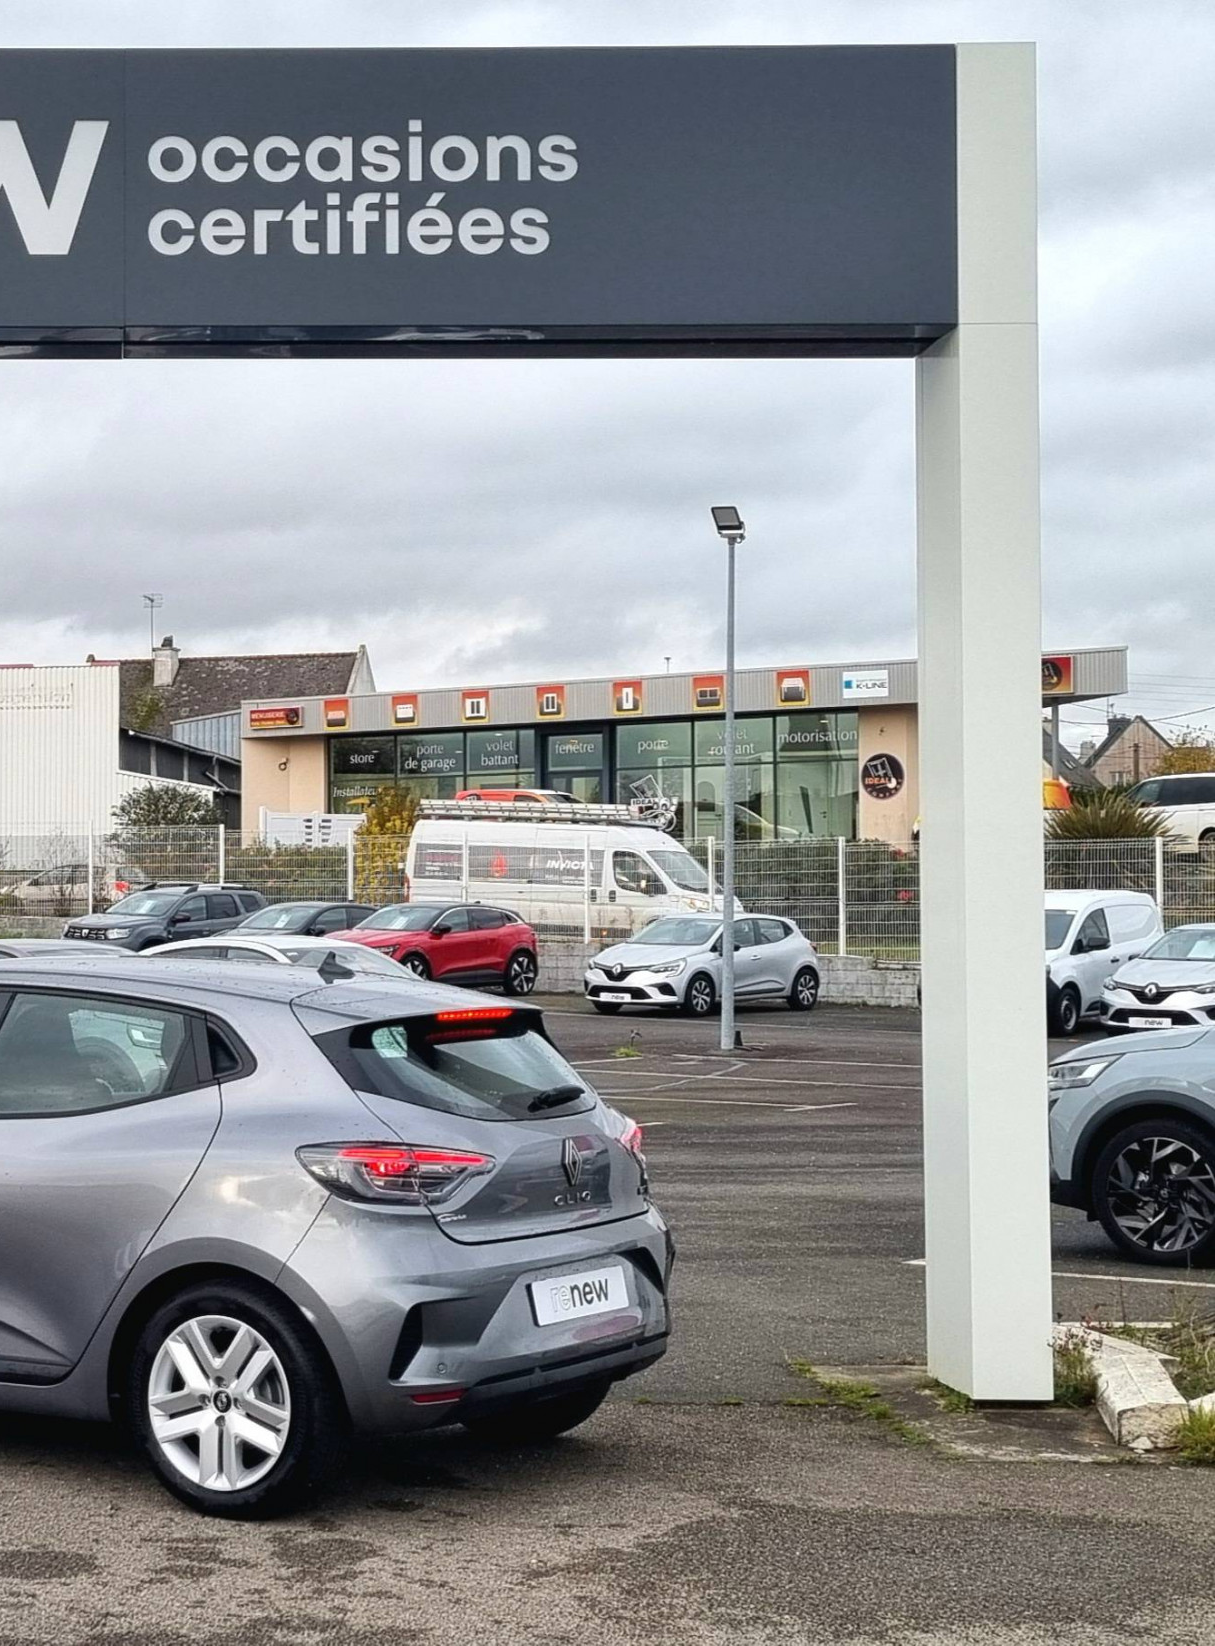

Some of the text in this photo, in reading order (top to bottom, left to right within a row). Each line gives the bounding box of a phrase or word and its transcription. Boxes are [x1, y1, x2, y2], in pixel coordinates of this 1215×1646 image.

[147, 118, 580, 184] occasions
[147, 187, 553, 257] certifiées
[778, 727, 858, 744] motorisation
[416, 743, 444, 758] porte
[486, 739, 514, 752] volet
[638, 739, 670, 754] porte
[349, 753, 375, 764] store
[404, 757, 456, 773] de garage
[481, 752, 519, 766] battant
[554, 1190, 591, 1206] CLIO
[550, 1278, 609, 1313] renew
